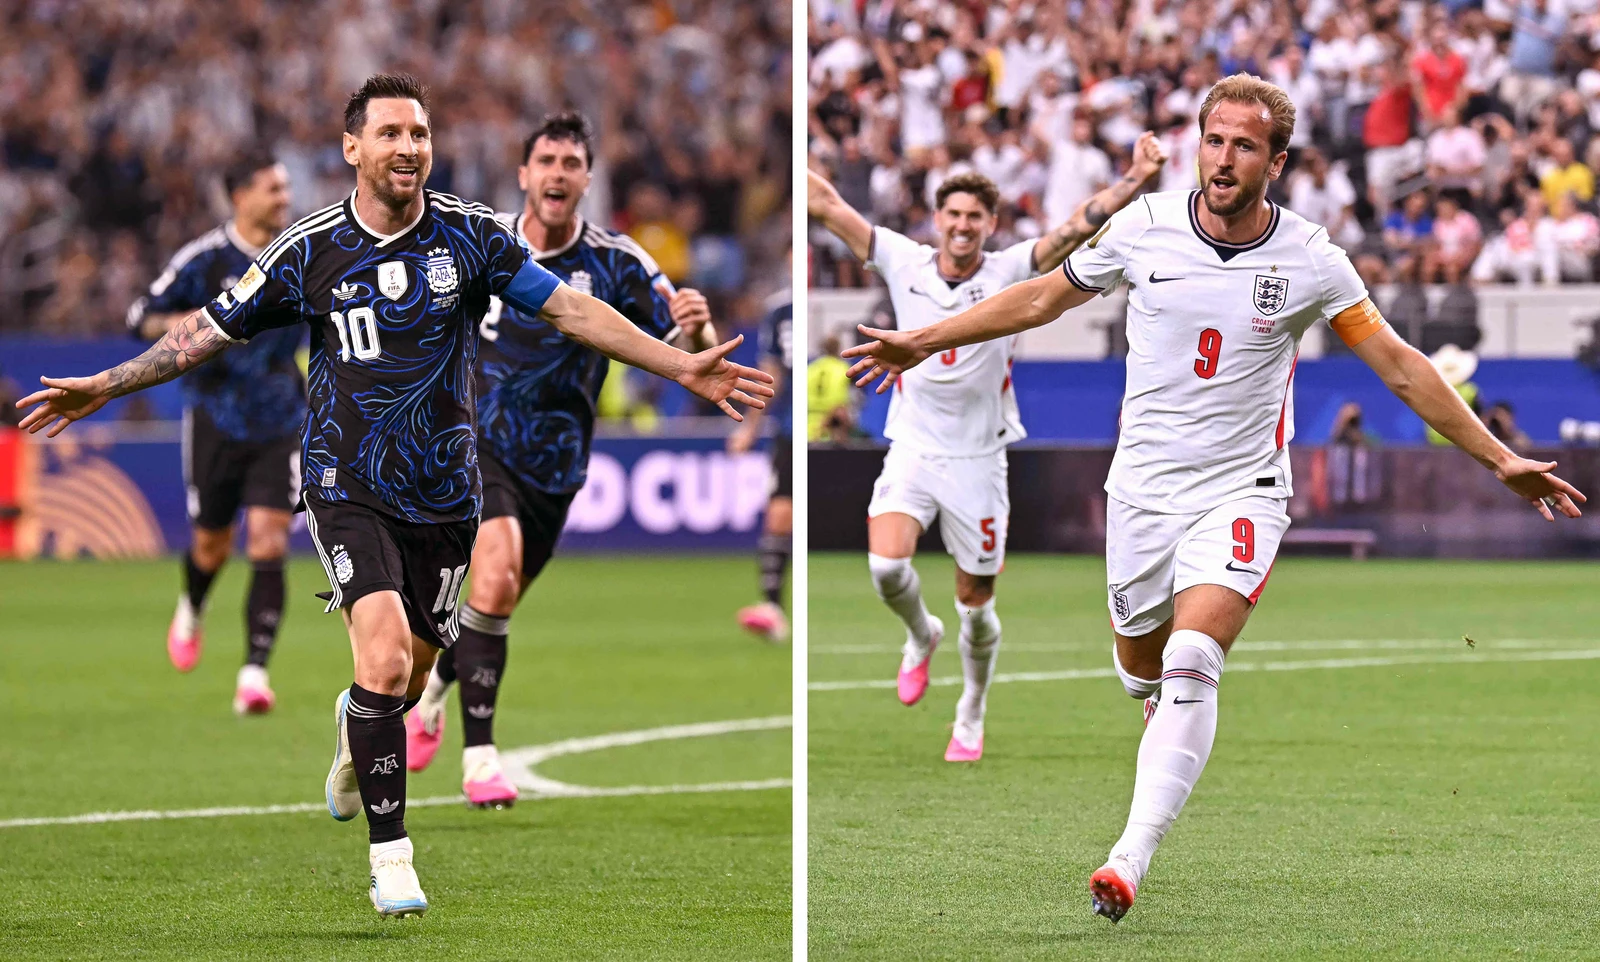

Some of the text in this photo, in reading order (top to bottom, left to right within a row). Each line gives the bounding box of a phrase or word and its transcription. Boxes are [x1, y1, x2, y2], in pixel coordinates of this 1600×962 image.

[330, 307, 381, 362] 10
[1251, 317, 1276, 326] CROATIA
[1194, 328, 1223, 380] 9
[630, 451, 778, 534] CUP
[980, 517, 996, 552] 5
[1232, 517, 1255, 564] 9
[370, 753, 399, 775] AFA
